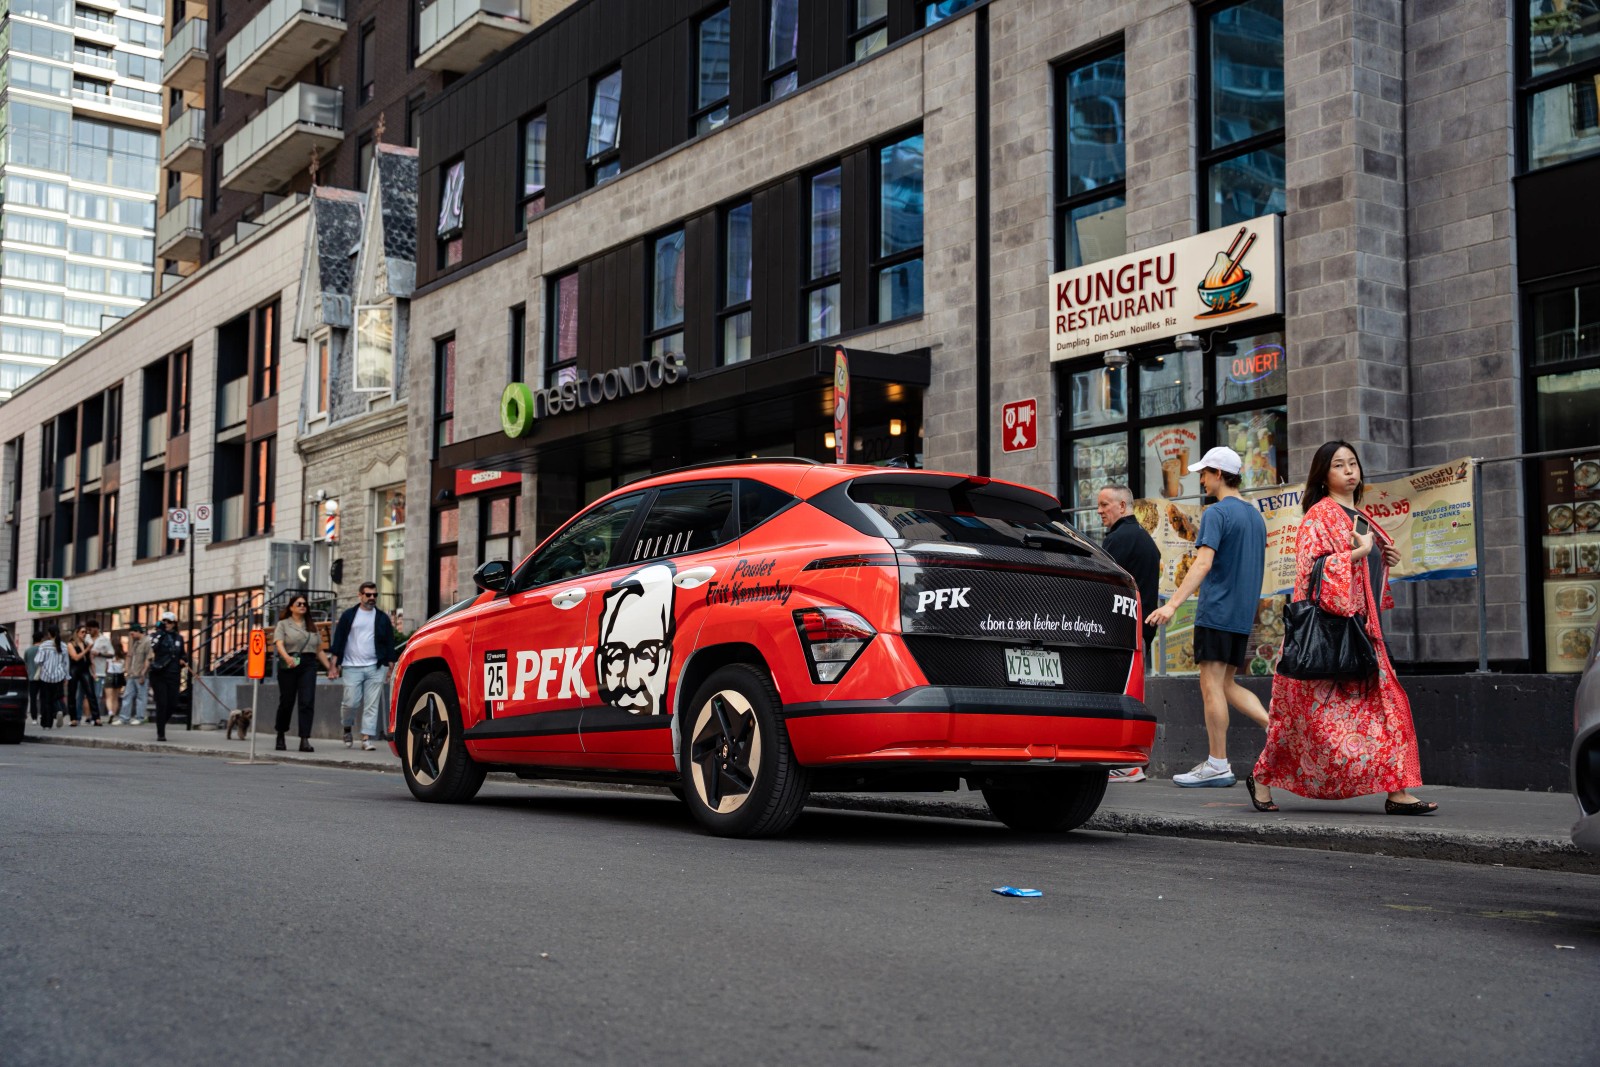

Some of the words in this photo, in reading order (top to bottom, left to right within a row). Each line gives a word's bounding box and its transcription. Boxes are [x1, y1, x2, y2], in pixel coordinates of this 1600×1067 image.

[1056, 252, 1176, 311] KUNGFU
[1056, 287, 1177, 335] RESTAURANT
[1211, 290, 1241, 311] 功夫
[1056, 337, 1090, 351] Dumpling
[1094, 333, 1109, 342] Dim
[1110, 329, 1126, 340] Sum
[1130, 321, 1161, 334] Nouilles
[1165, 317, 1177, 327] Riz
[1232, 352, 1280, 377] OUVERT
[1410, 467, 1454, 486] KUNGFU
[1413, 475, 1454, 490] RESTAURANT
[1365, 498, 1410, 519] $43.95
[1412, 505, 1447, 518] BREUVAGES
[1448, 501, 1471, 511] FROIDS
[1422, 514, 1437, 522] COLD
[1439, 510, 1460, 519] DRINKS
[1281, 525, 1286, 534] 2
[730, 558, 776, 581] Poulet
[705, 581, 729, 606] Frit
[729, 580, 793, 607] Kentucky
[915, 587, 971, 613] PFK
[1112, 594, 1138, 620] PFK
[1007, 617, 1014, 630] à
[1033, 614, 1060, 632] lécher
[1062, 615, 1073, 631] les
[1026, 650, 1045, 658] Québec
[512, 646, 594, 701] PFK
[1007, 655, 1032, 676] X79
[1037, 657, 1059, 678] VKY
[488, 665, 504, 696] 25
